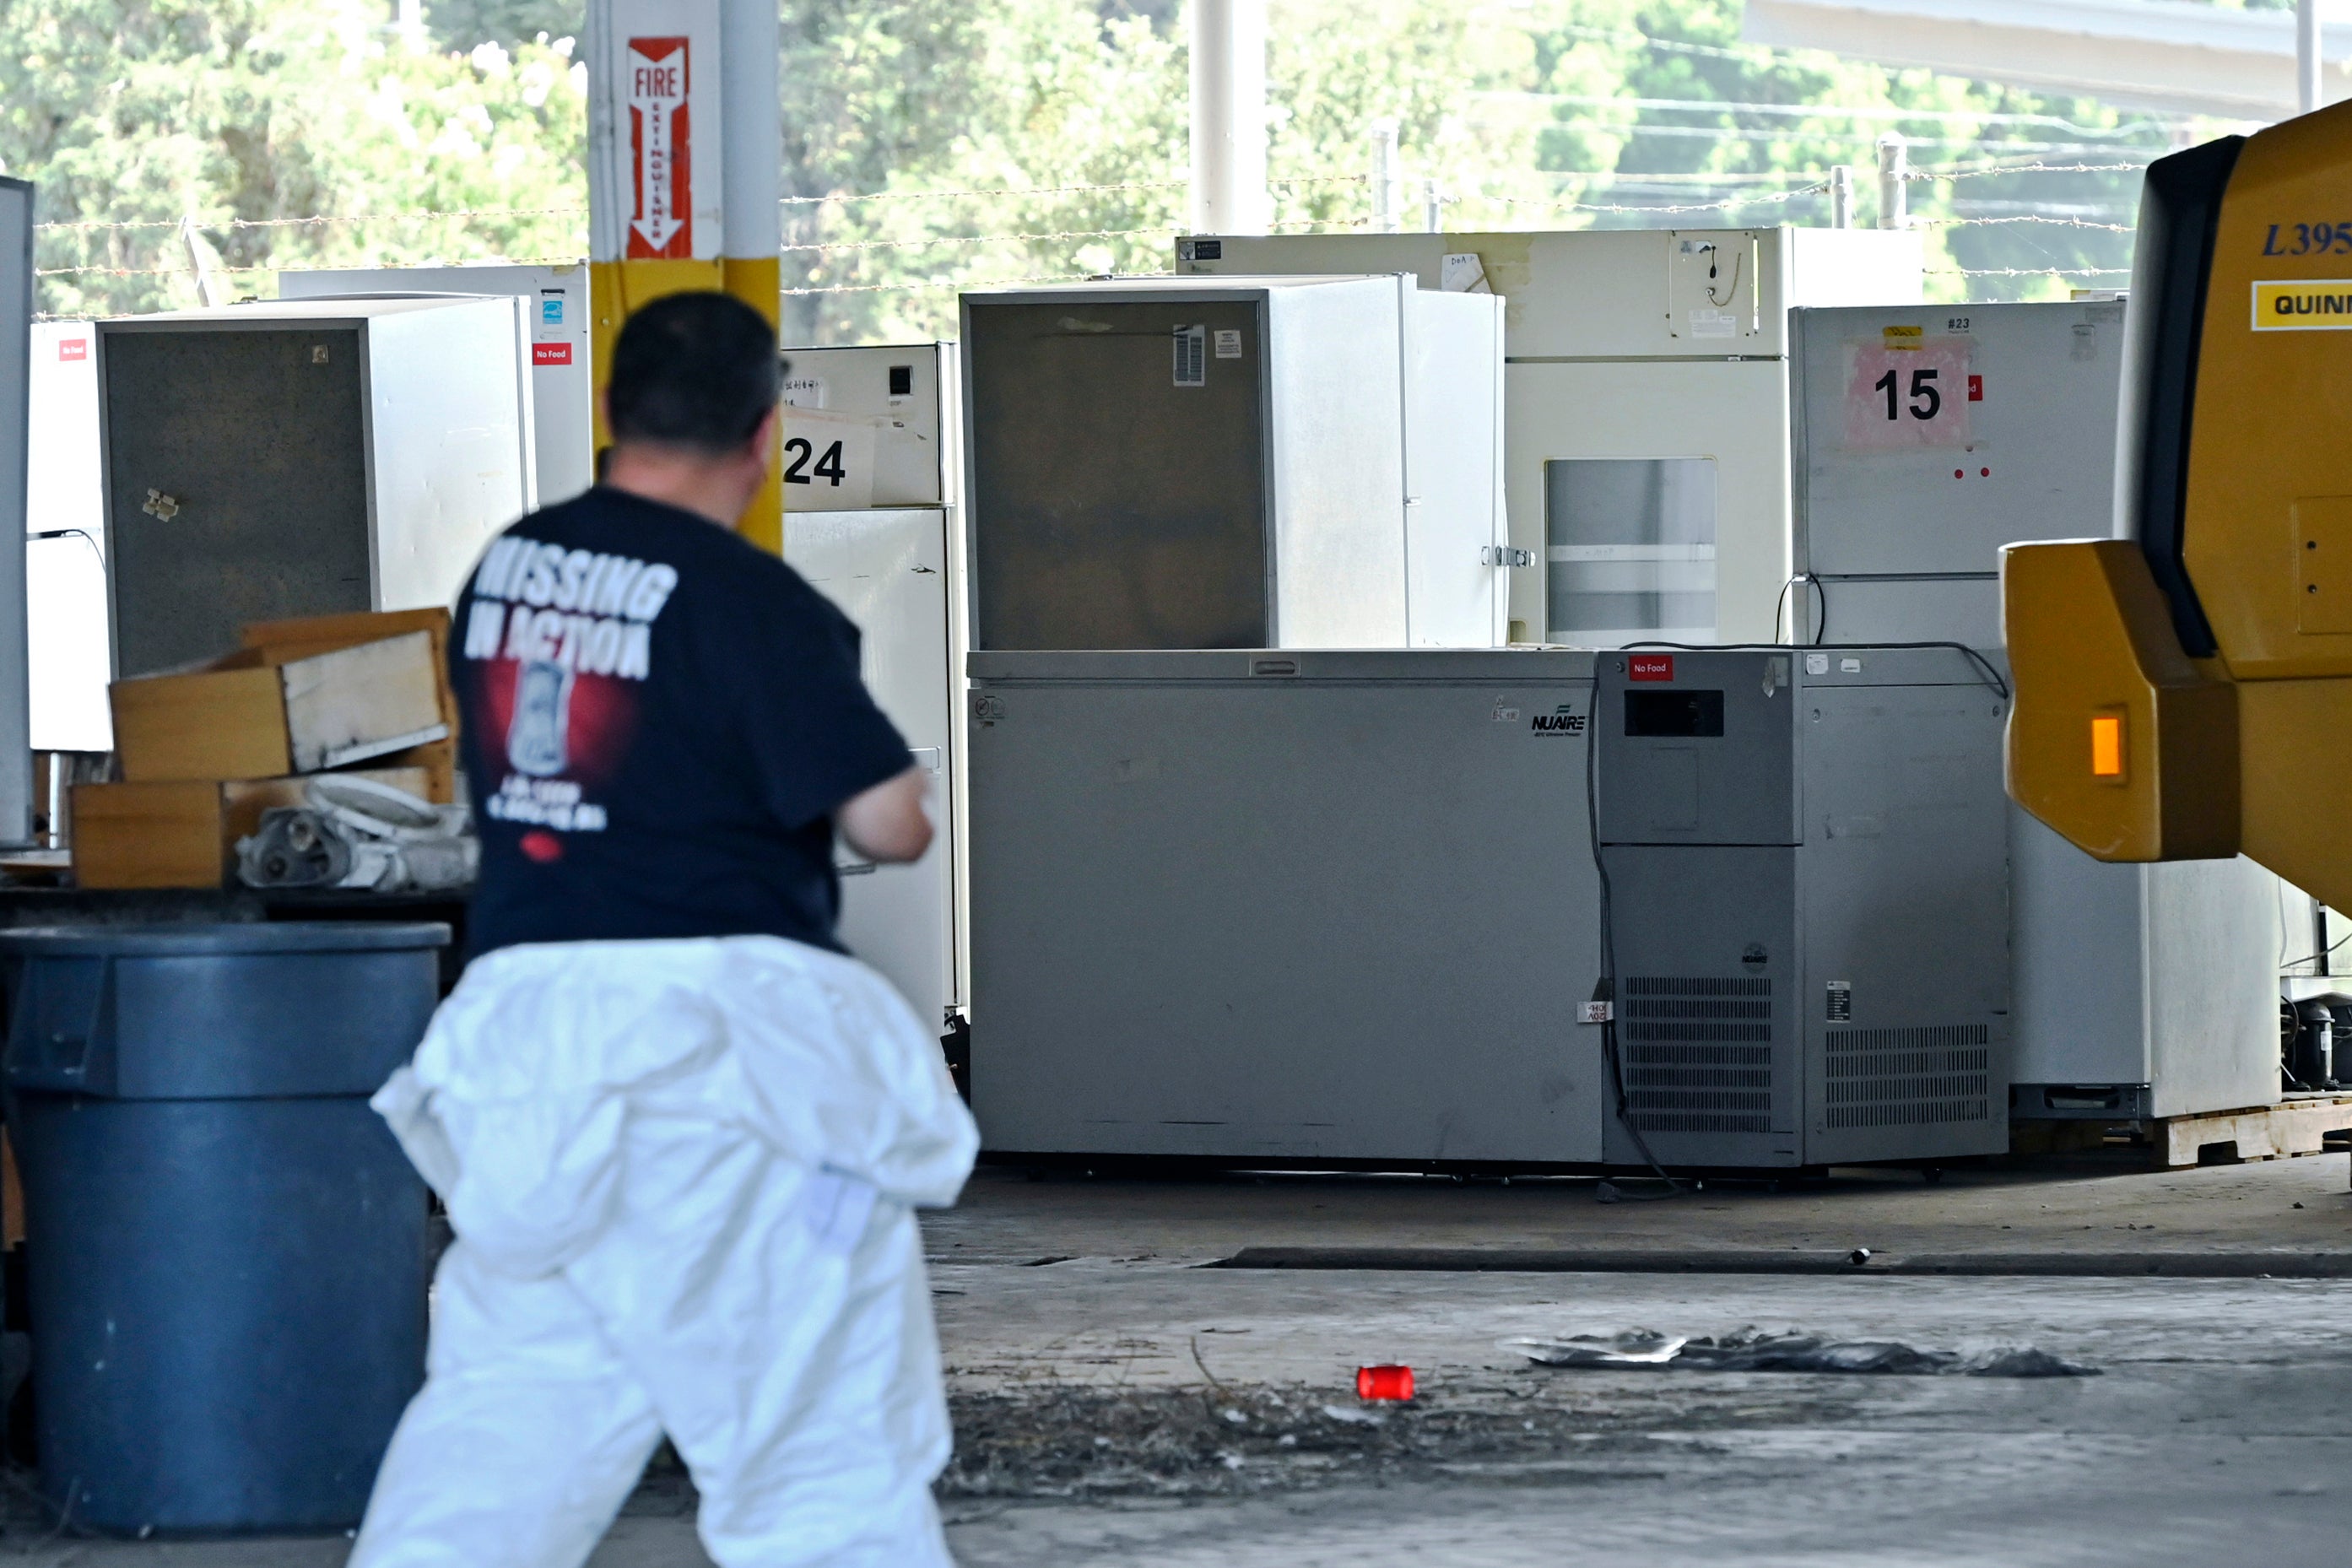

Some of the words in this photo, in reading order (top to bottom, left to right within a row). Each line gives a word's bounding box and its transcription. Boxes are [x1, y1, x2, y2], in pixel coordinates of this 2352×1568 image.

[635, 67, 678, 98] FIRE
[650, 102, 663, 239] EXTINGUISHER
[2275, 295, 2352, 315] QUIN
[1948, 318, 1970, 329] #23
[548, 349, 566, 358] Food
[1875, 369, 1940, 420] 15
[783, 437, 846, 487] 24
[464, 598, 506, 660] IN
[1634, 664, 1646, 673] No
[1647, 663, 1667, 673] Food
[1532, 716, 1586, 731] NUAIRE
